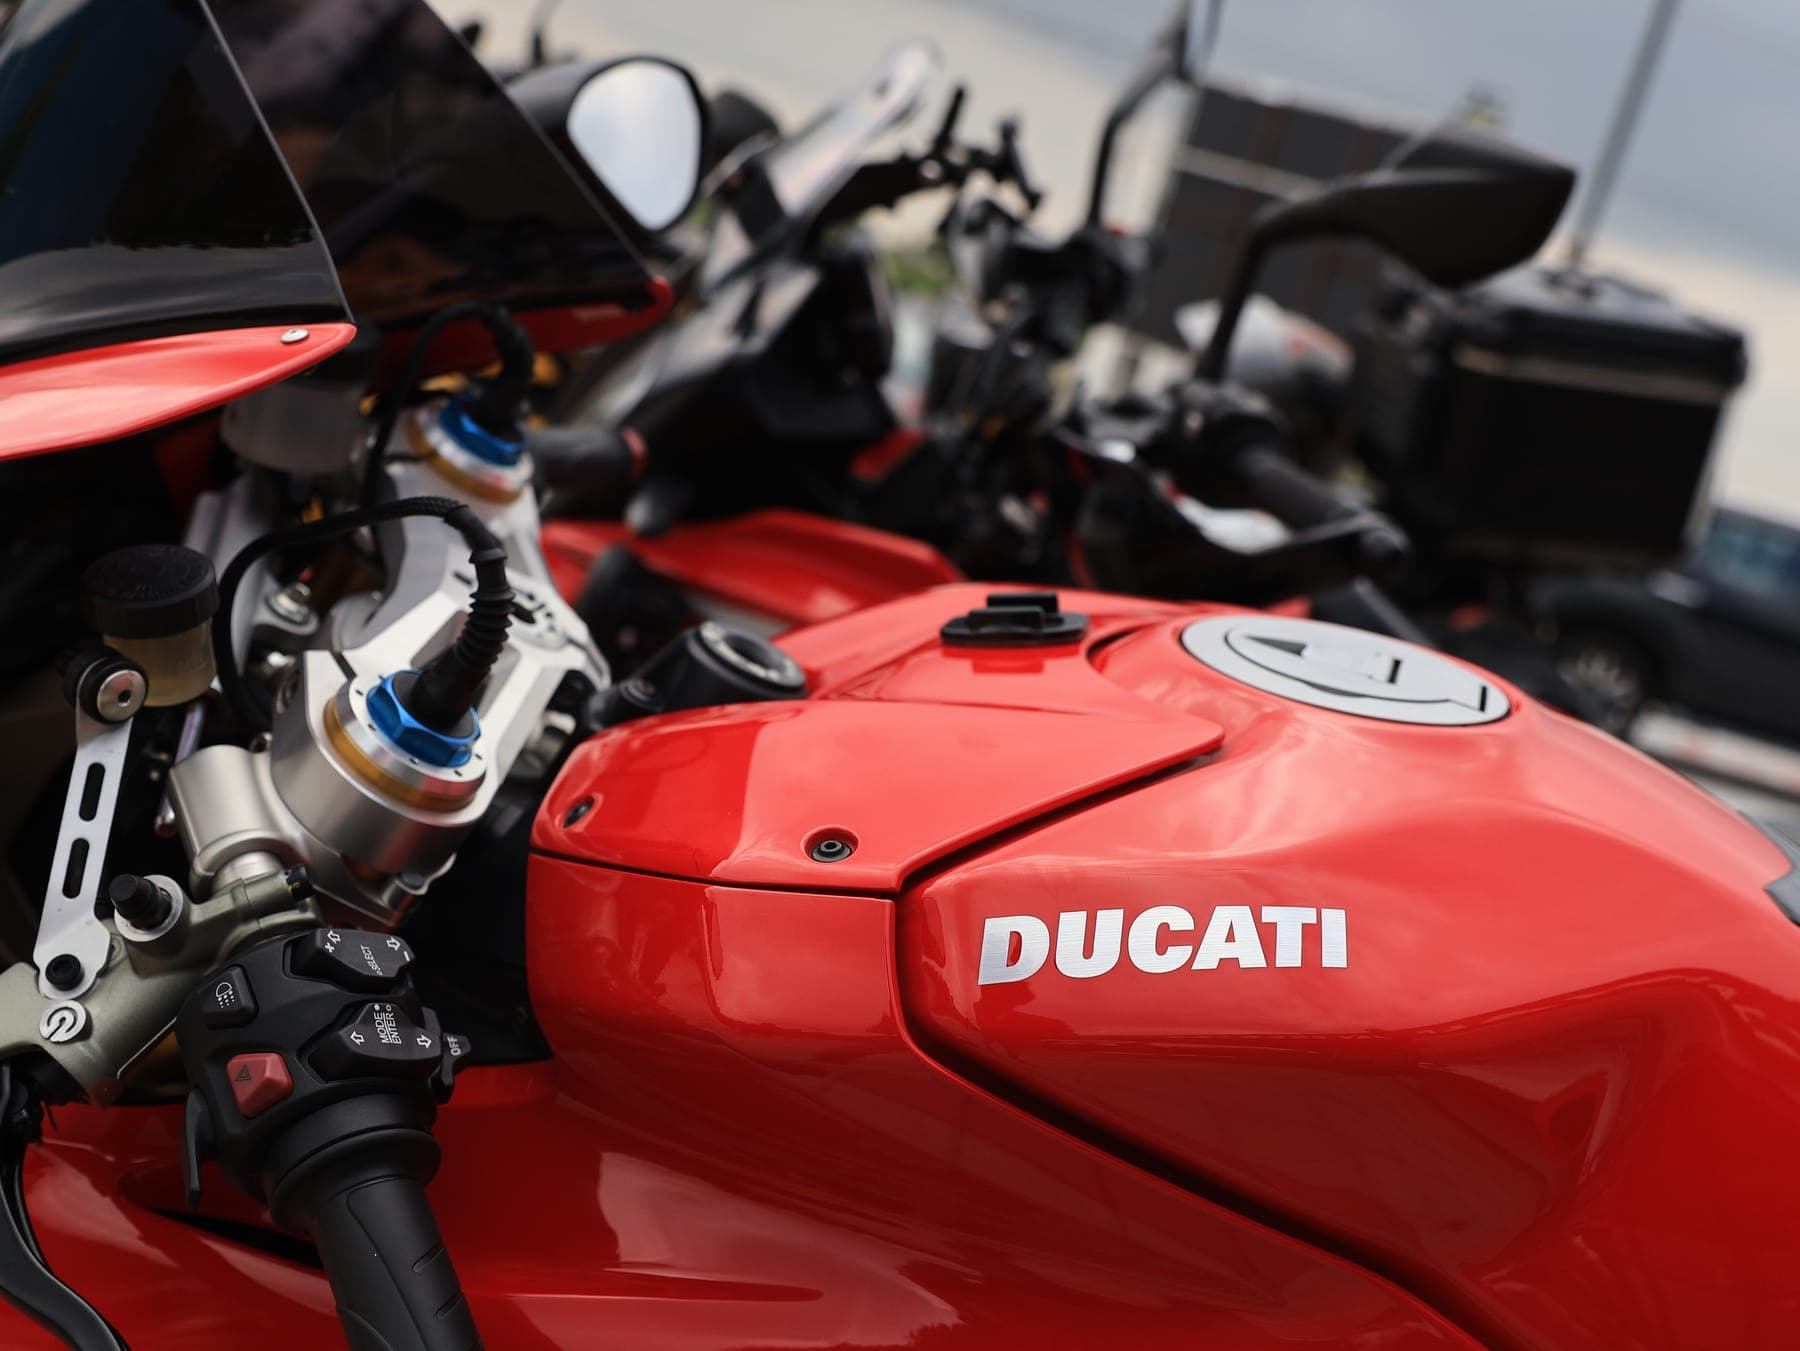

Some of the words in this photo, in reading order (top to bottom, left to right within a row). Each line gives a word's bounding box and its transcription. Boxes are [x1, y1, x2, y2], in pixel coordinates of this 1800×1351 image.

[360, 944, 381, 973] SELECT
[977, 905, 1348, 986] DUCATI
[374, 1012, 391, 1044] MODE
[385, 1012, 402, 1045] ENTER
[446, 1035, 462, 1056] OFF
